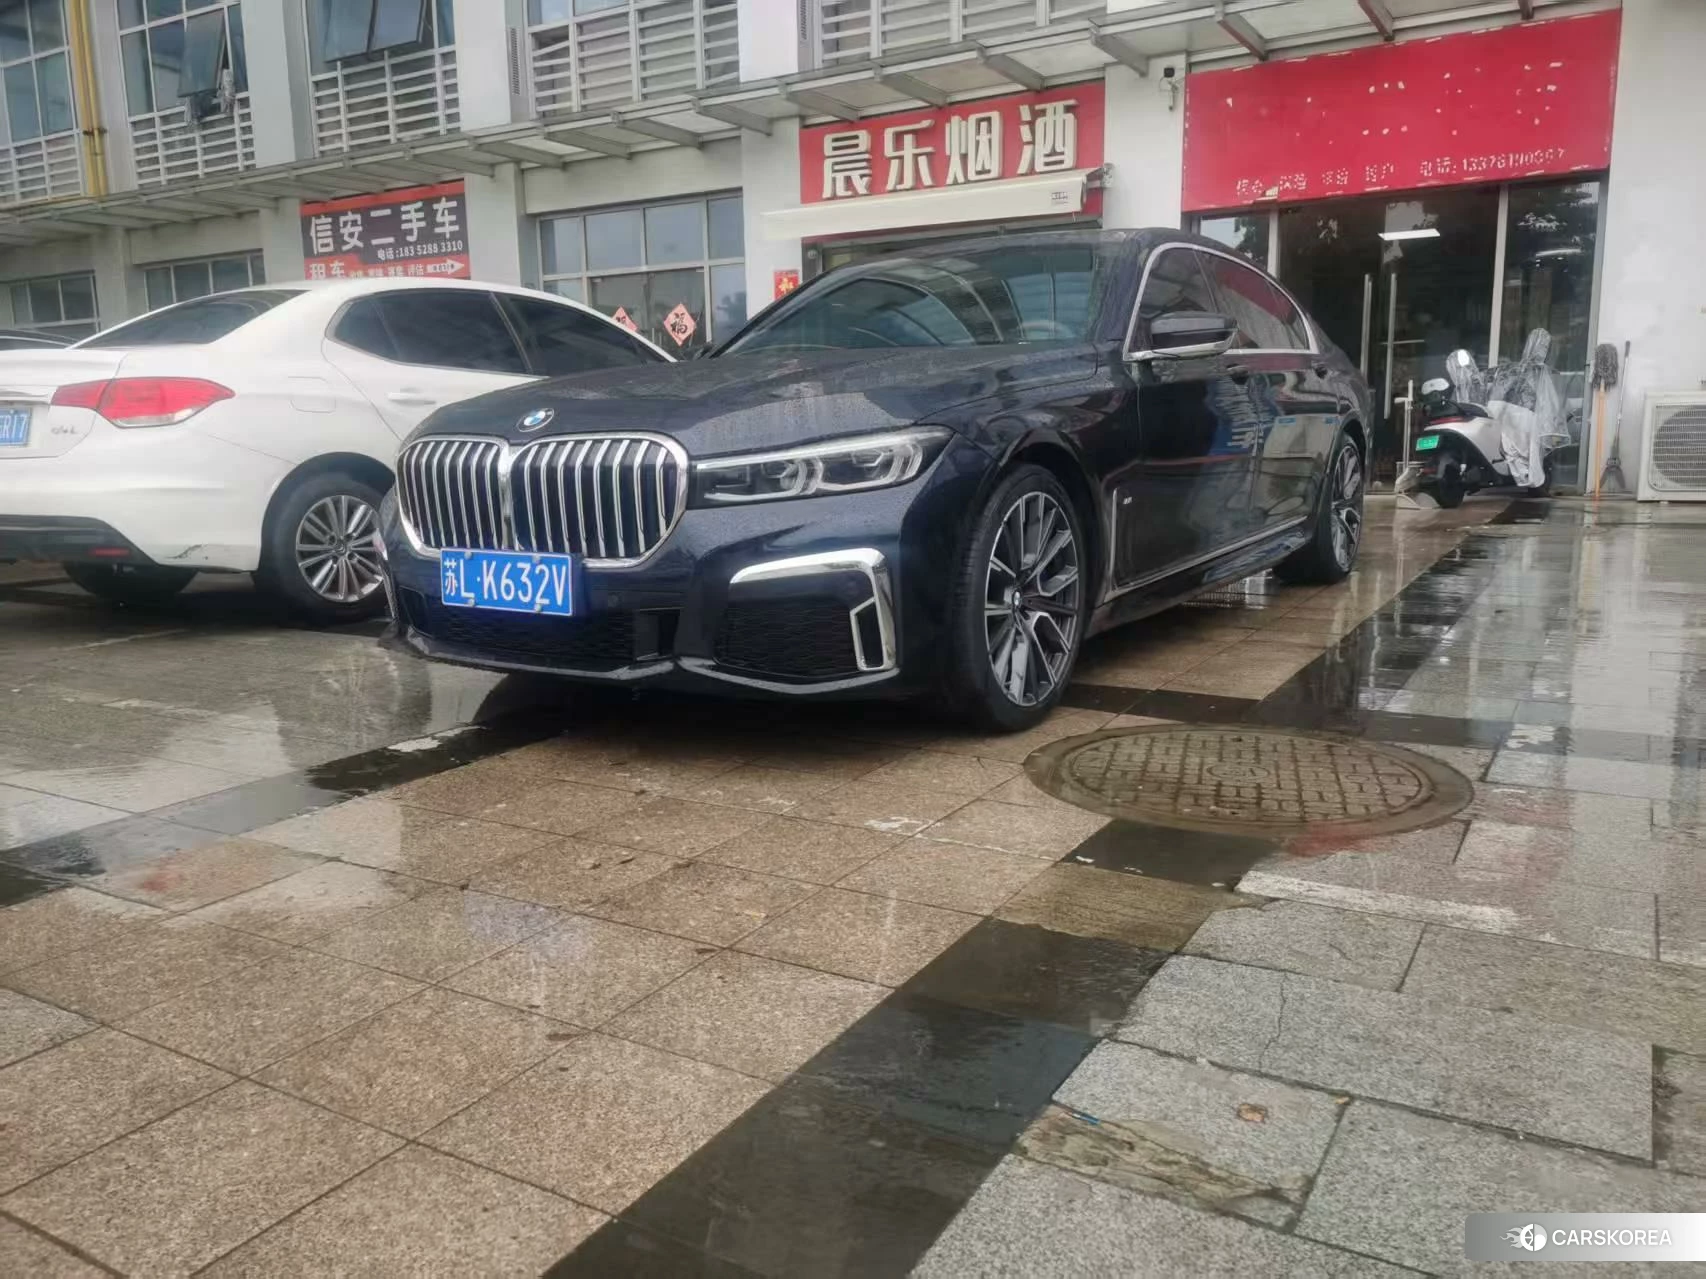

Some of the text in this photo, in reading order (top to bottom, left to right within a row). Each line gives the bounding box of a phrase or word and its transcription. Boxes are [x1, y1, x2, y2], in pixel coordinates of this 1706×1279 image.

[822, 99, 1078, 199] 晨乐烟酒
[310, 196, 459, 256] 信安二手车
[671, 312, 688, 334] 福
[444, 558, 566, 606] 苏L·K632V
